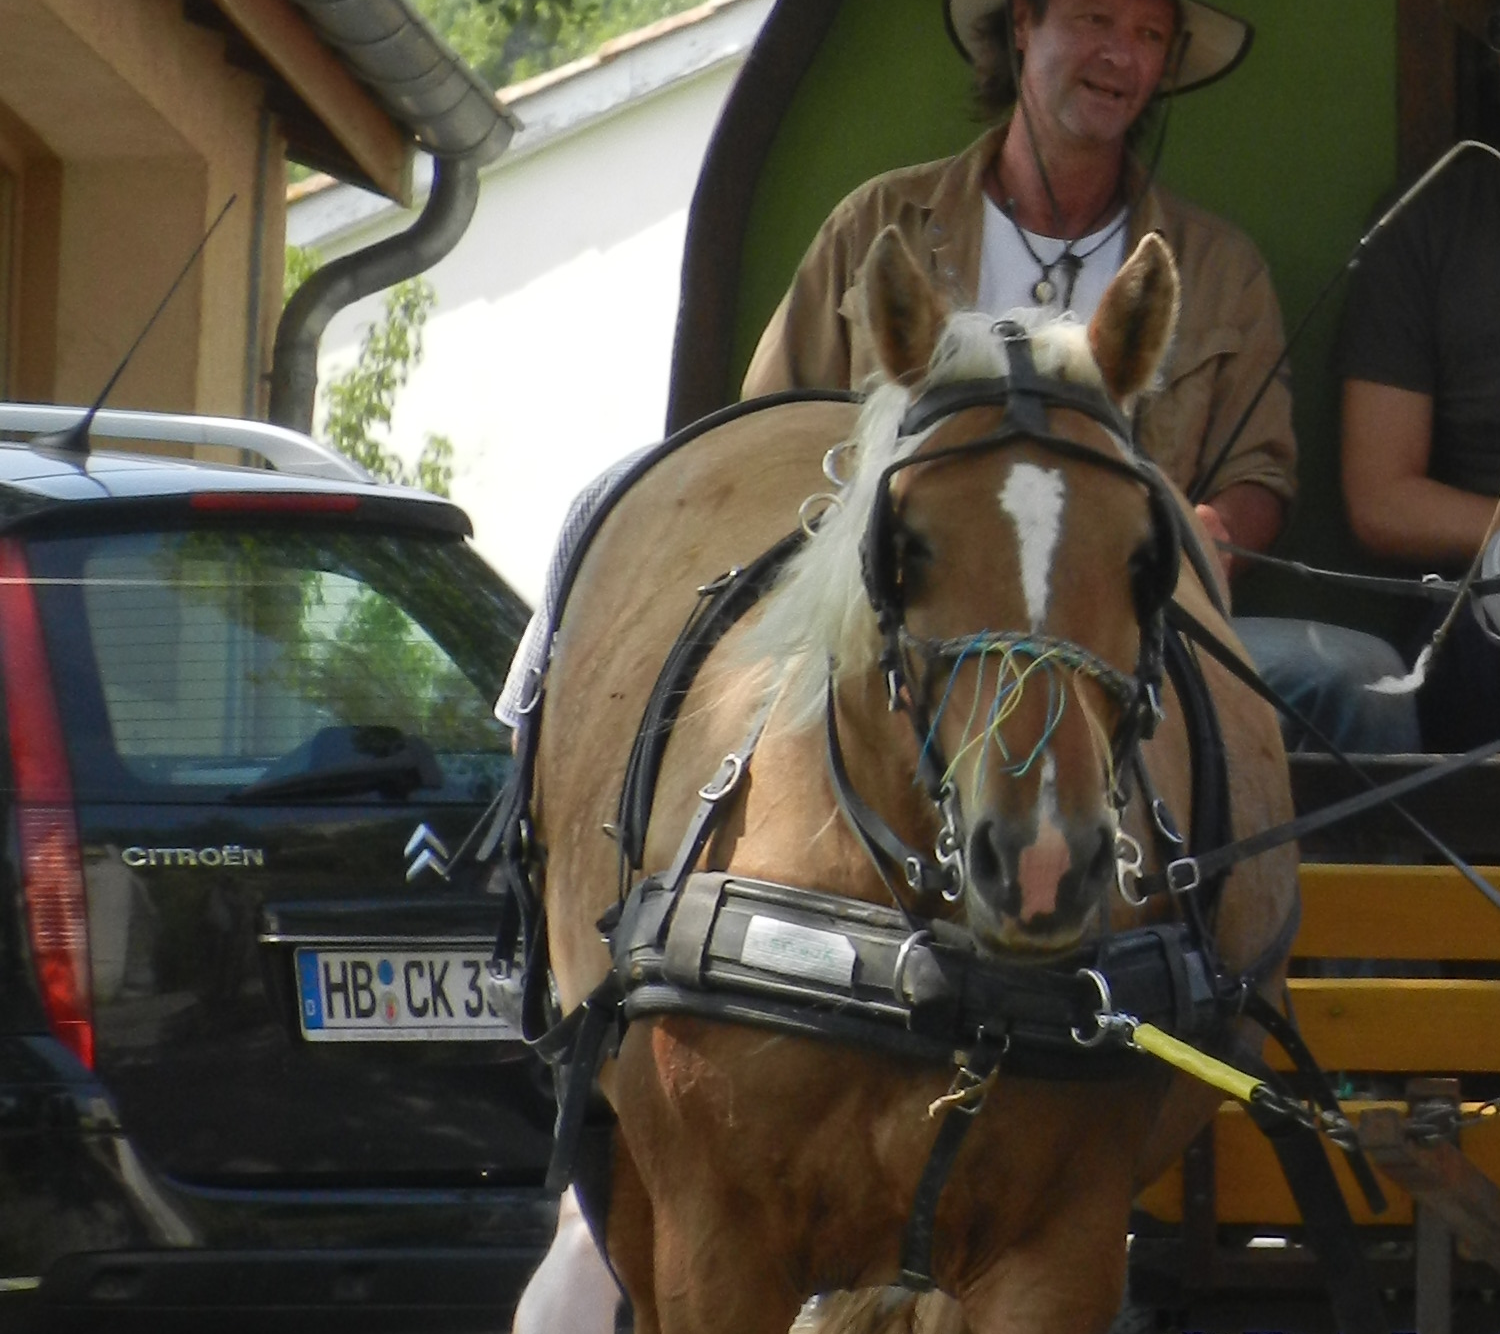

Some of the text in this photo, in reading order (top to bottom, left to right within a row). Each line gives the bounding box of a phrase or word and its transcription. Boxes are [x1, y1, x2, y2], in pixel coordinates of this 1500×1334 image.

[121, 845, 265, 867] CITROËN
[324, 961, 377, 1019] HB
[404, 960, 456, 1018] CK
